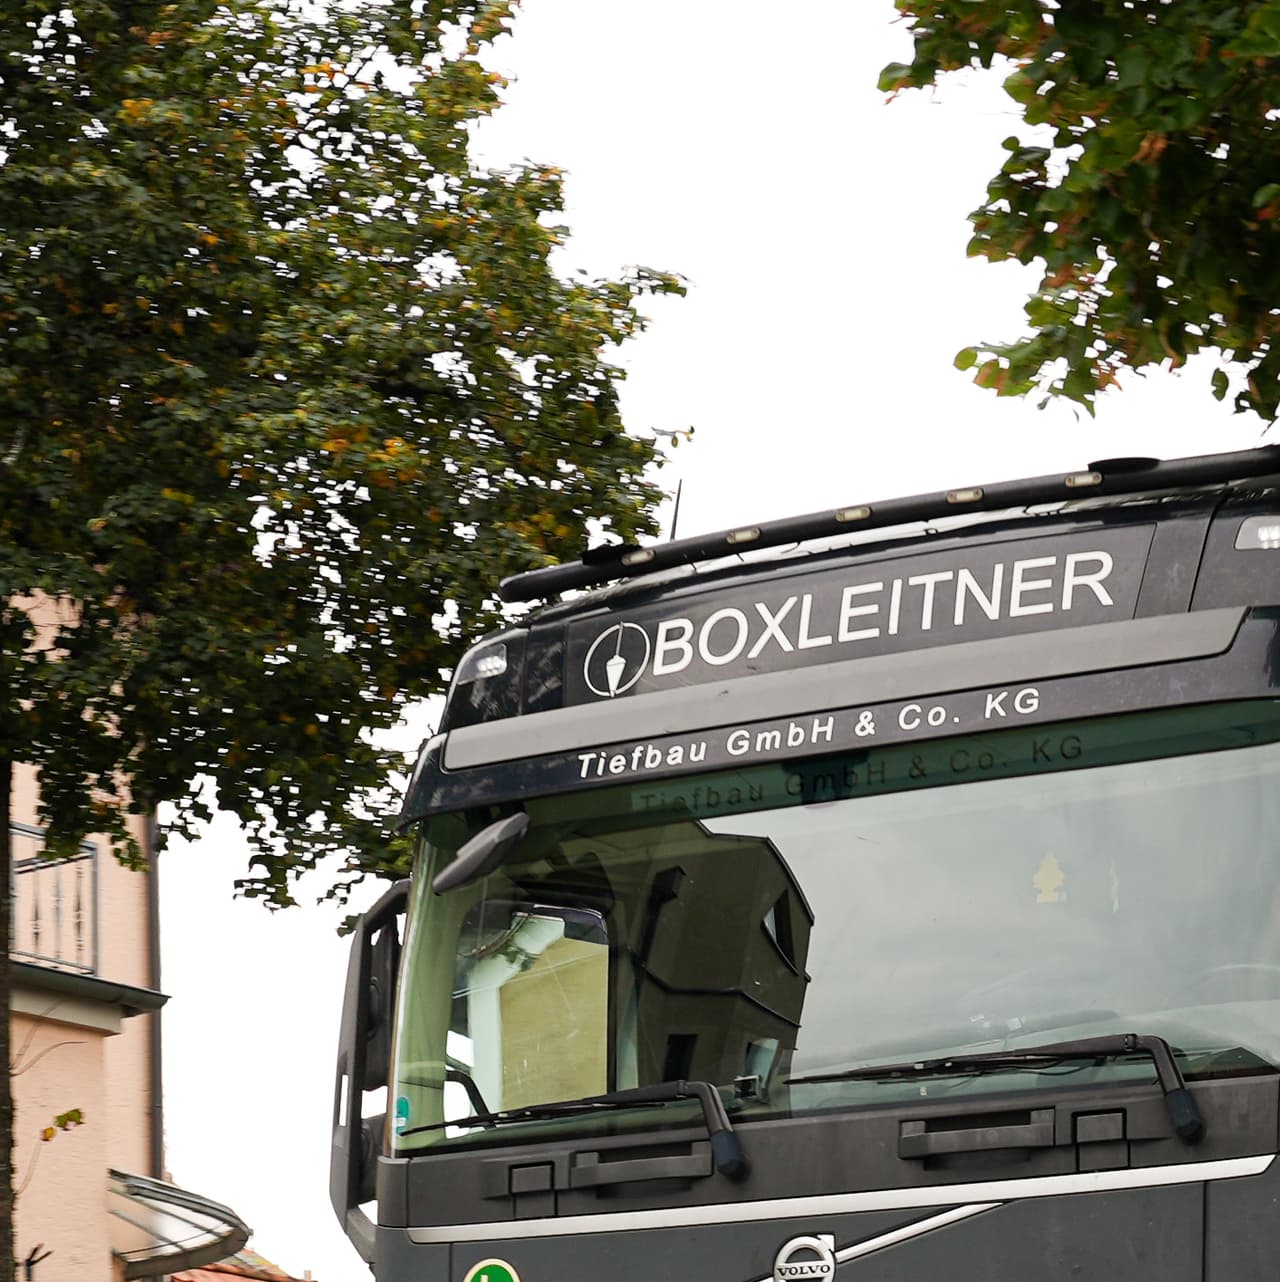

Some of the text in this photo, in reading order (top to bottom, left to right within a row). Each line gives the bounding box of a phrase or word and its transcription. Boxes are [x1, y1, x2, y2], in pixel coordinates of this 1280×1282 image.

[652, 550, 1115, 677] BOXLEITNER
[577, 687, 1040, 779] Tiefbau GmbH & Co. KG
[776, 1263, 831, 1278] VOLVO
